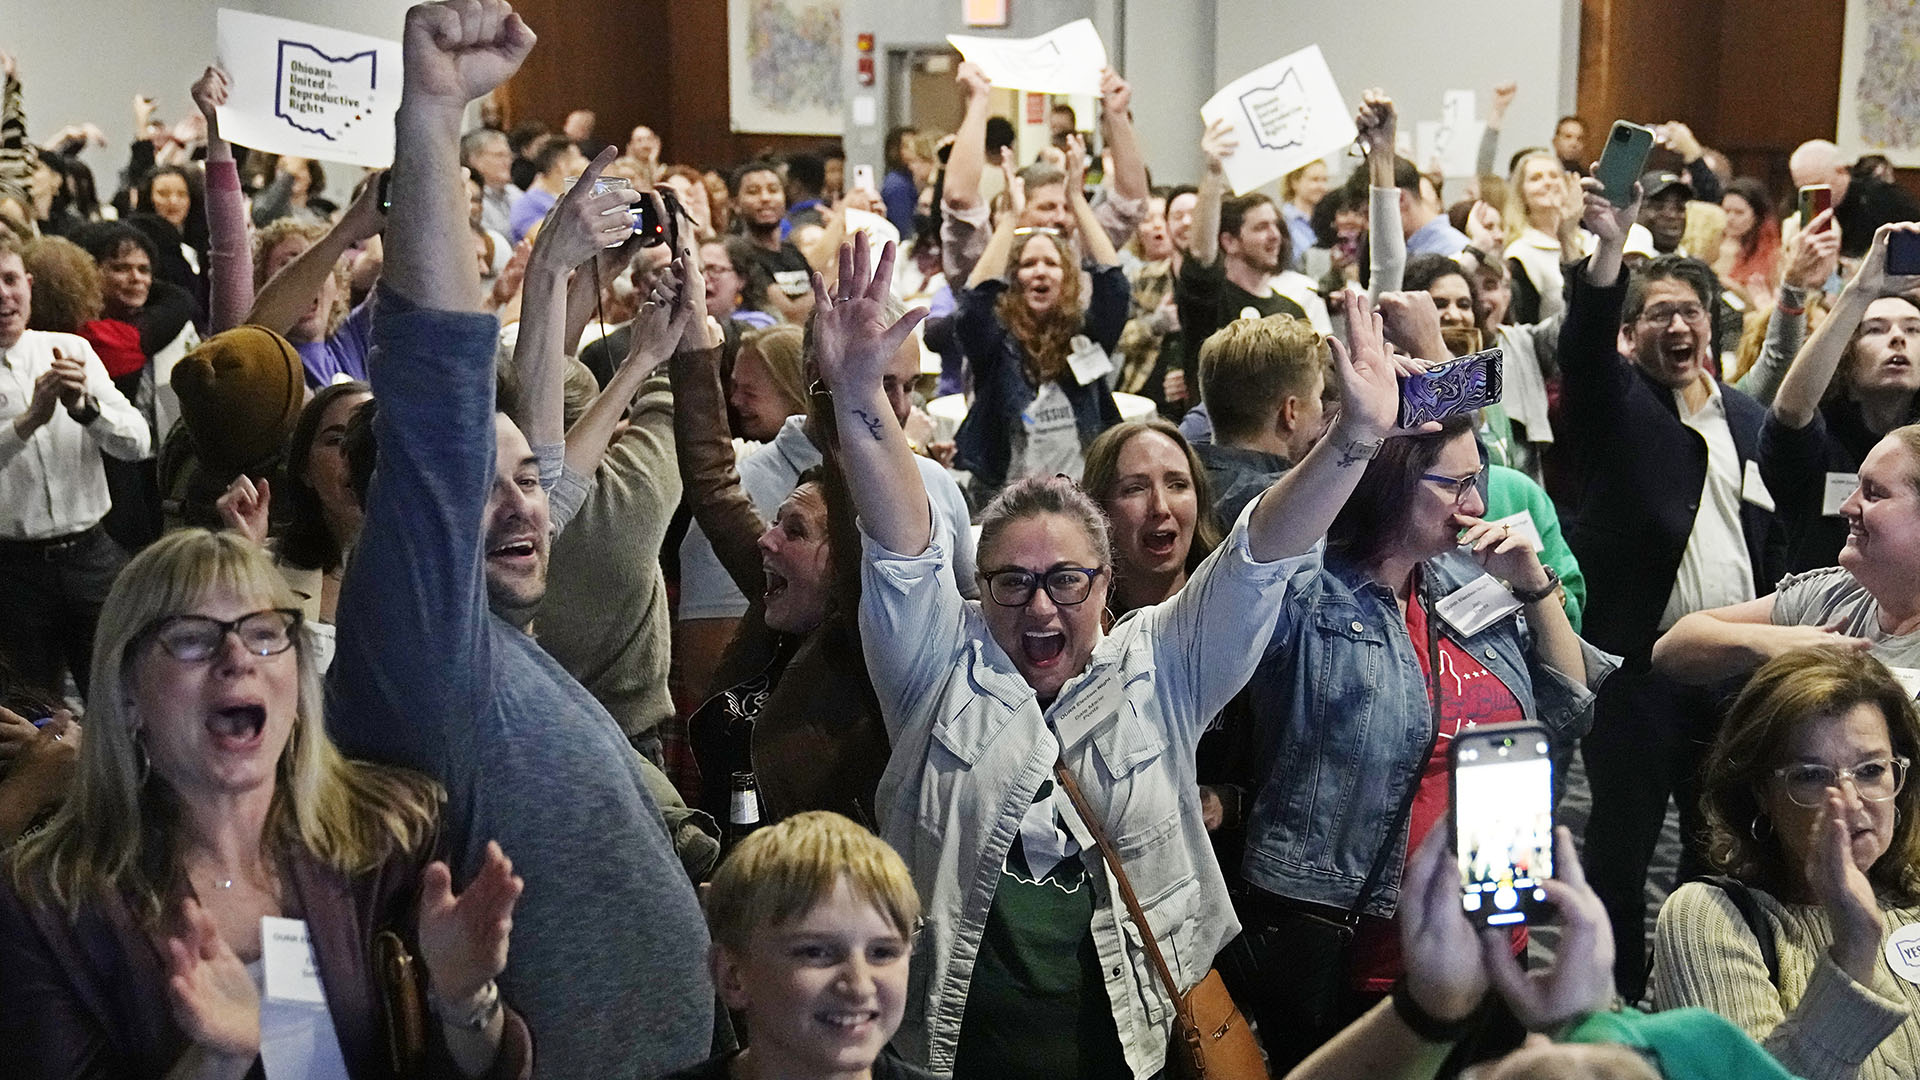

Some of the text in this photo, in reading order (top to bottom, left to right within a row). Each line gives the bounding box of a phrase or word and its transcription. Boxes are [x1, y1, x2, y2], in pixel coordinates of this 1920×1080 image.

[290, 60, 332, 79] Ohioans
[289, 73, 325, 89] United
[289, 85, 360, 107] Reproductive
[289, 98, 325, 114] Rights
[1076, 689, 1097, 707] Election
[1097, 677, 1111, 690] Night
